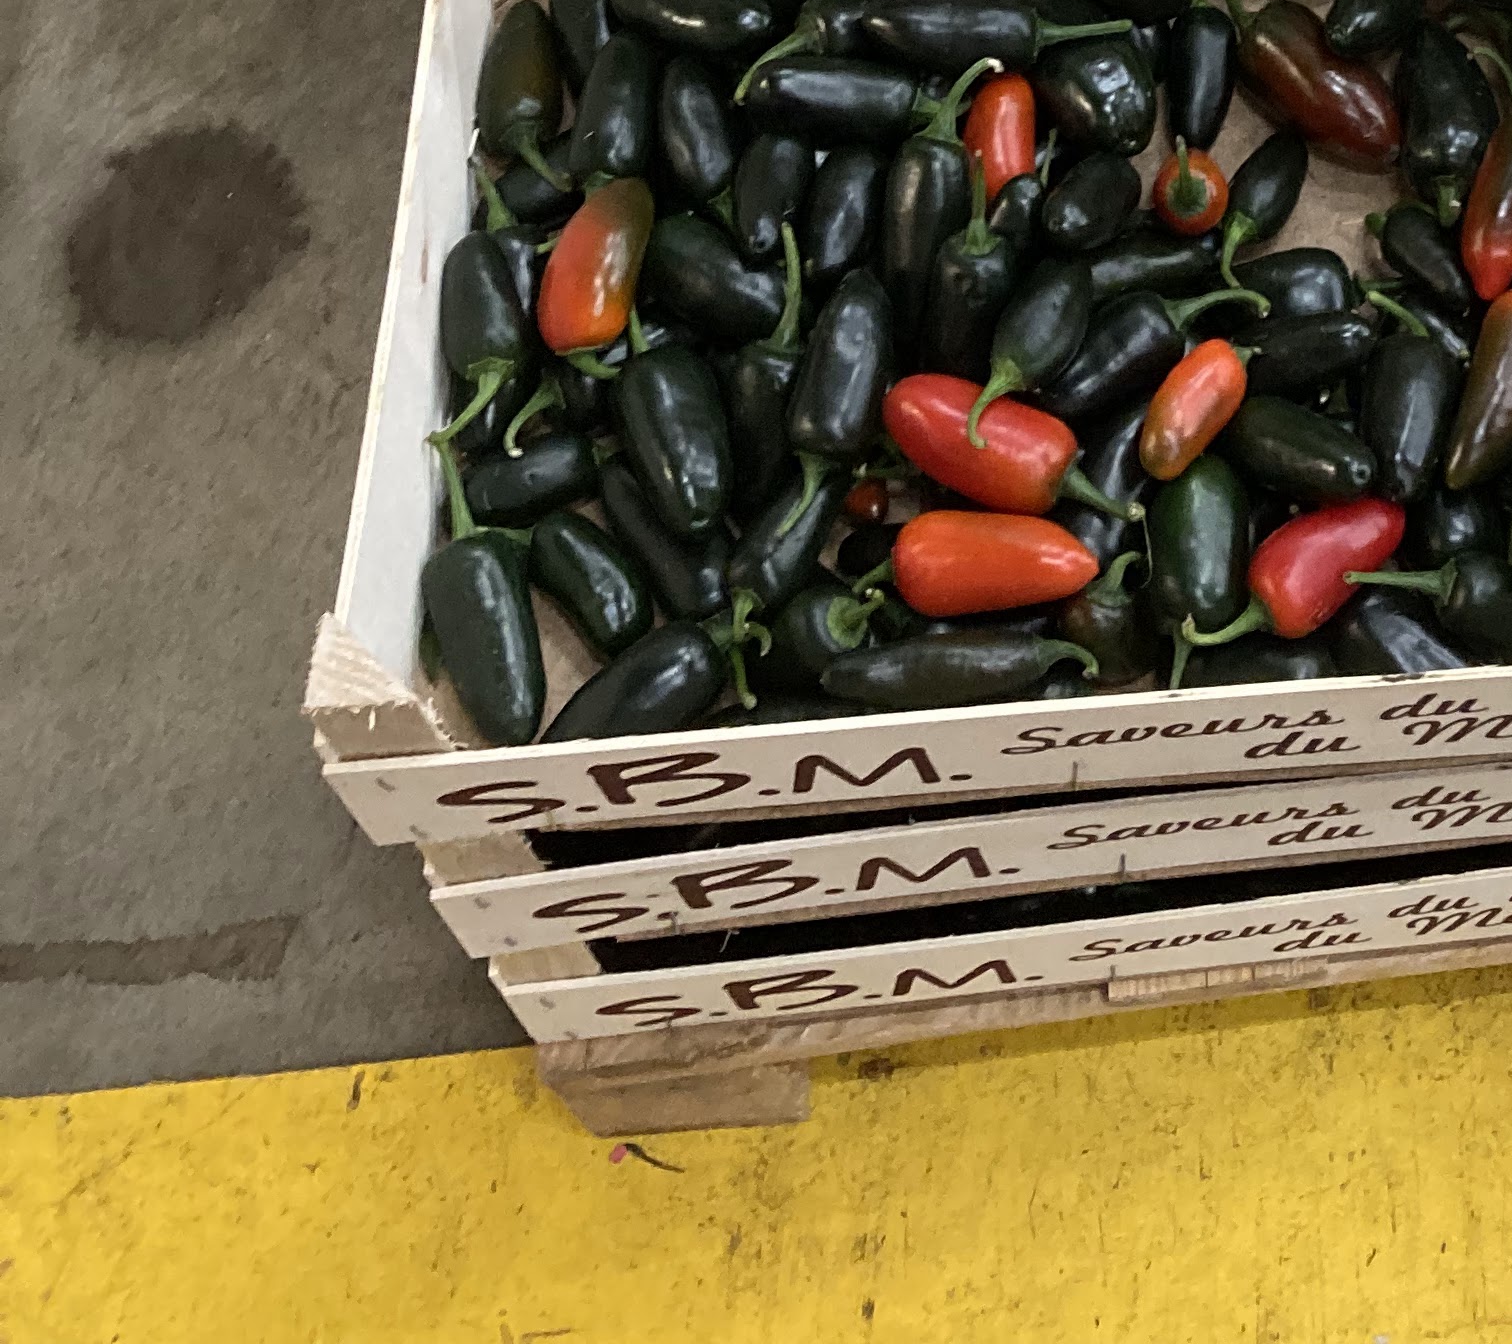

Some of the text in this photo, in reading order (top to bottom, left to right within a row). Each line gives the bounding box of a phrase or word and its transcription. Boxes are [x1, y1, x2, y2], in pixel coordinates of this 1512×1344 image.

[1001, 709, 1344, 754] Saveurs
[1380, 694, 1478, 721] du
[1244, 731, 1360, 758] du
[436, 747, 971, 823] S.B.M.
[1047, 801, 1353, 850] Saveurs
[1391, 785, 1481, 811] du
[1267, 822, 1372, 846] du
[532, 847, 1018, 933] S.B.M.
[1068, 913, 1355, 961] Saveurs
[1388, 895, 1478, 919] du
[1274, 930, 1371, 952] du
[595, 959, 1043, 1026] S.B.M.
